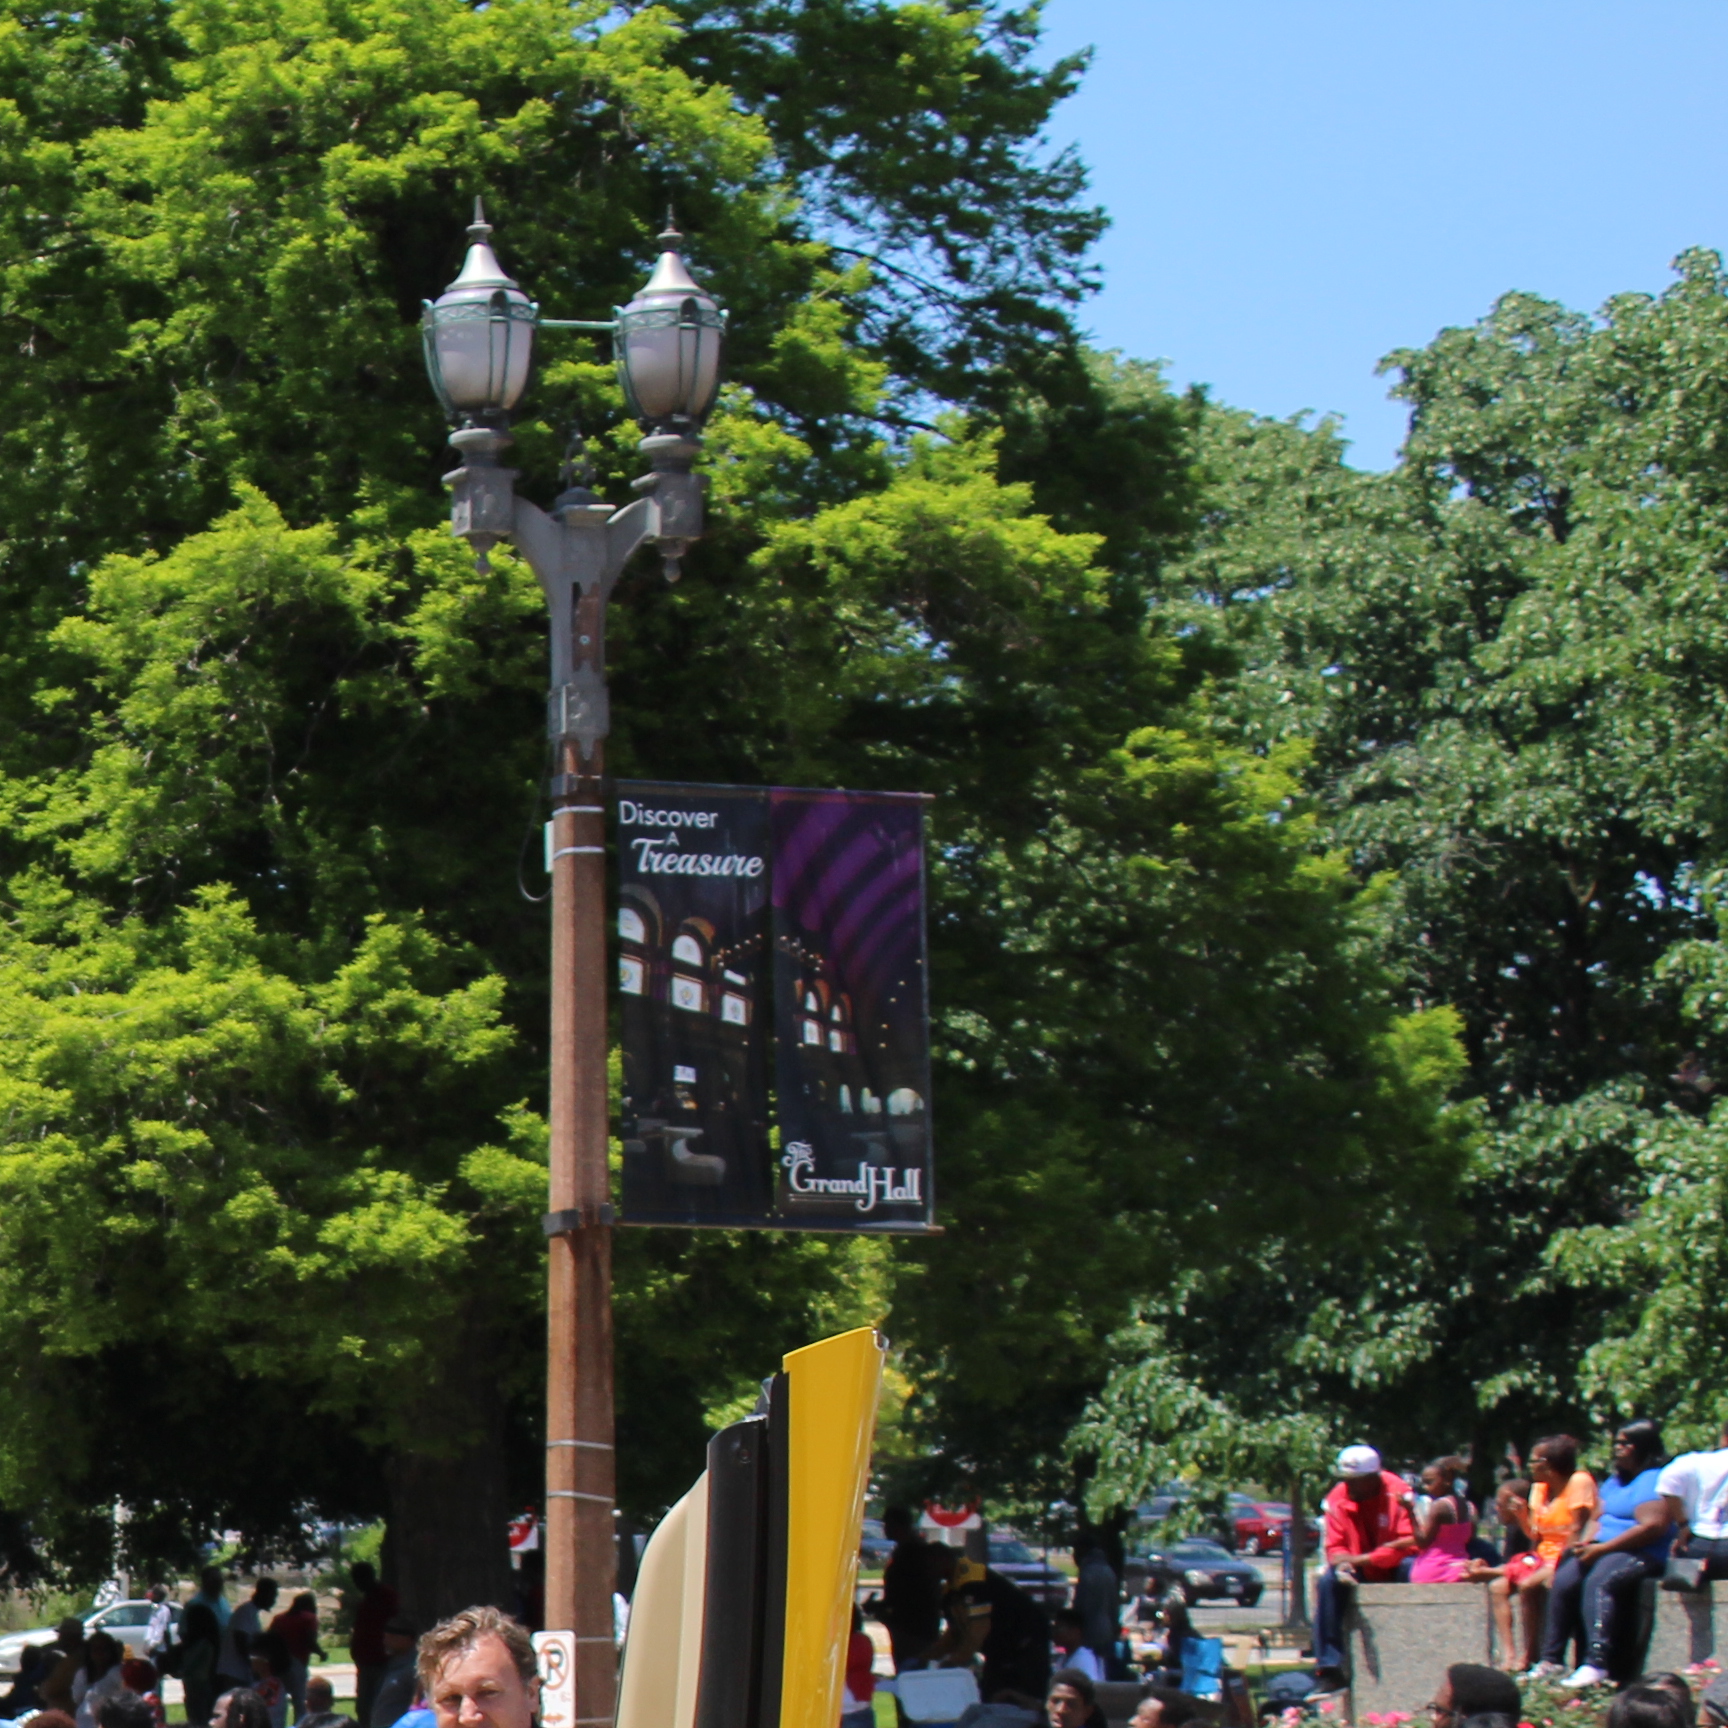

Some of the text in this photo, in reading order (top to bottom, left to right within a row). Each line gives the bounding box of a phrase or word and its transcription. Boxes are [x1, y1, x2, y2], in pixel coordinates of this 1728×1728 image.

[619, 801, 718, 828] Discover
[666, 831, 680, 847] A
[631, 837, 765, 877] Treasure
